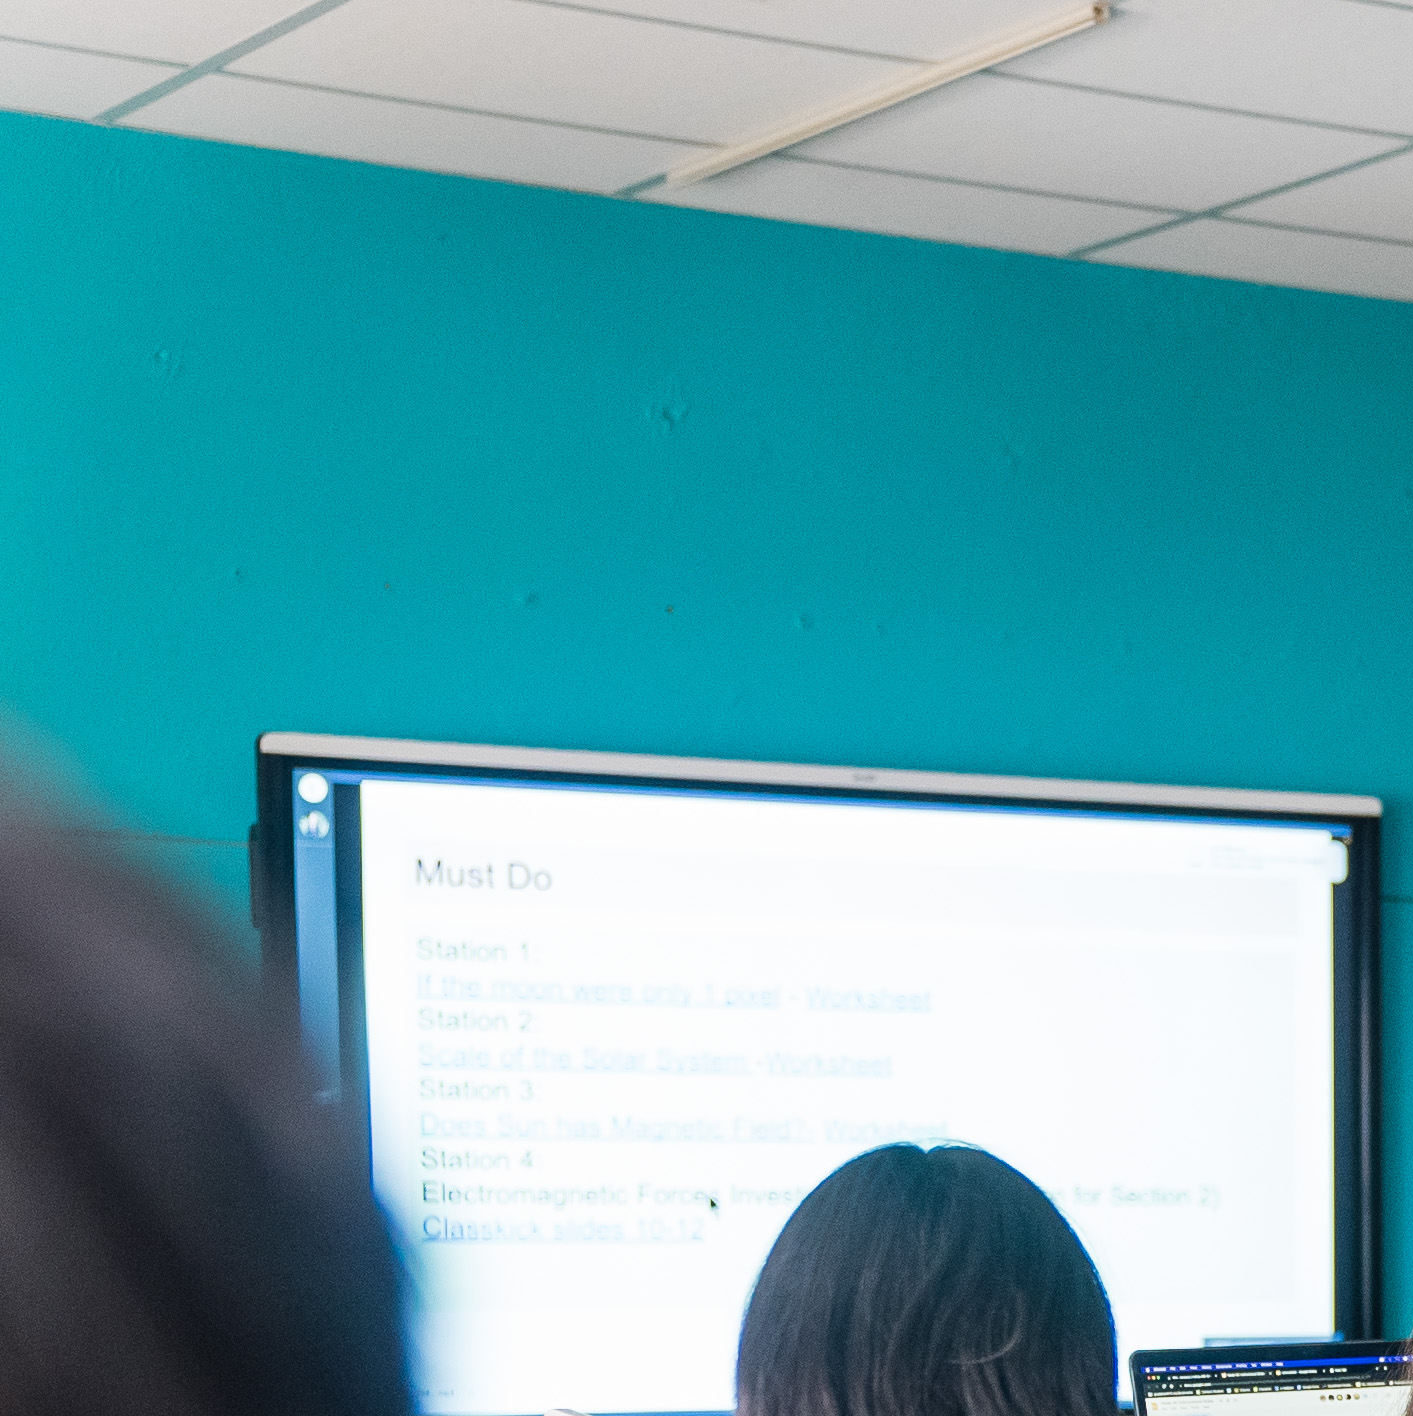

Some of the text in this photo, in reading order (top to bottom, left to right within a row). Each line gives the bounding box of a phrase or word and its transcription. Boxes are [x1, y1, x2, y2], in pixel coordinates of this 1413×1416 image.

[414, 856, 553, 892] Must Do
[416, 936, 508, 963] Station
[440, 975, 482, 1000] the
[490, 980, 563, 1001] moon
[572, 984, 634, 1003] were
[642, 983, 694, 1009] only
[723, 983, 781, 1010] pixel
[805, 985, 933, 1011] Worksheet
[416, 1006, 509, 1034] Station
[417, 1041, 491, 1069] Scale
[498, 1042, 525, 1069] of
[532, 1044, 573, 1071] the
[582, 1045, 647, 1072] Solar
[655, 1047, 748, 1078] System
[418, 1076, 510, 1104] Station
[419, 1111, 487, 1138] Does
[496, 1111, 549, 1139] Sun
[555, 1114, 602, 1140] has
[609, 1115, 724, 1144] Magnetic
[421, 1146, 511, 1173] Station
[420, 1180, 628, 1212] Electromagnetic
[1071, 1184, 1103, 1208] for
[1108, 1183, 1193, 1208] Section
[422, 1215, 543, 1242] Classkick
[552, 1217, 627, 1243] slides
